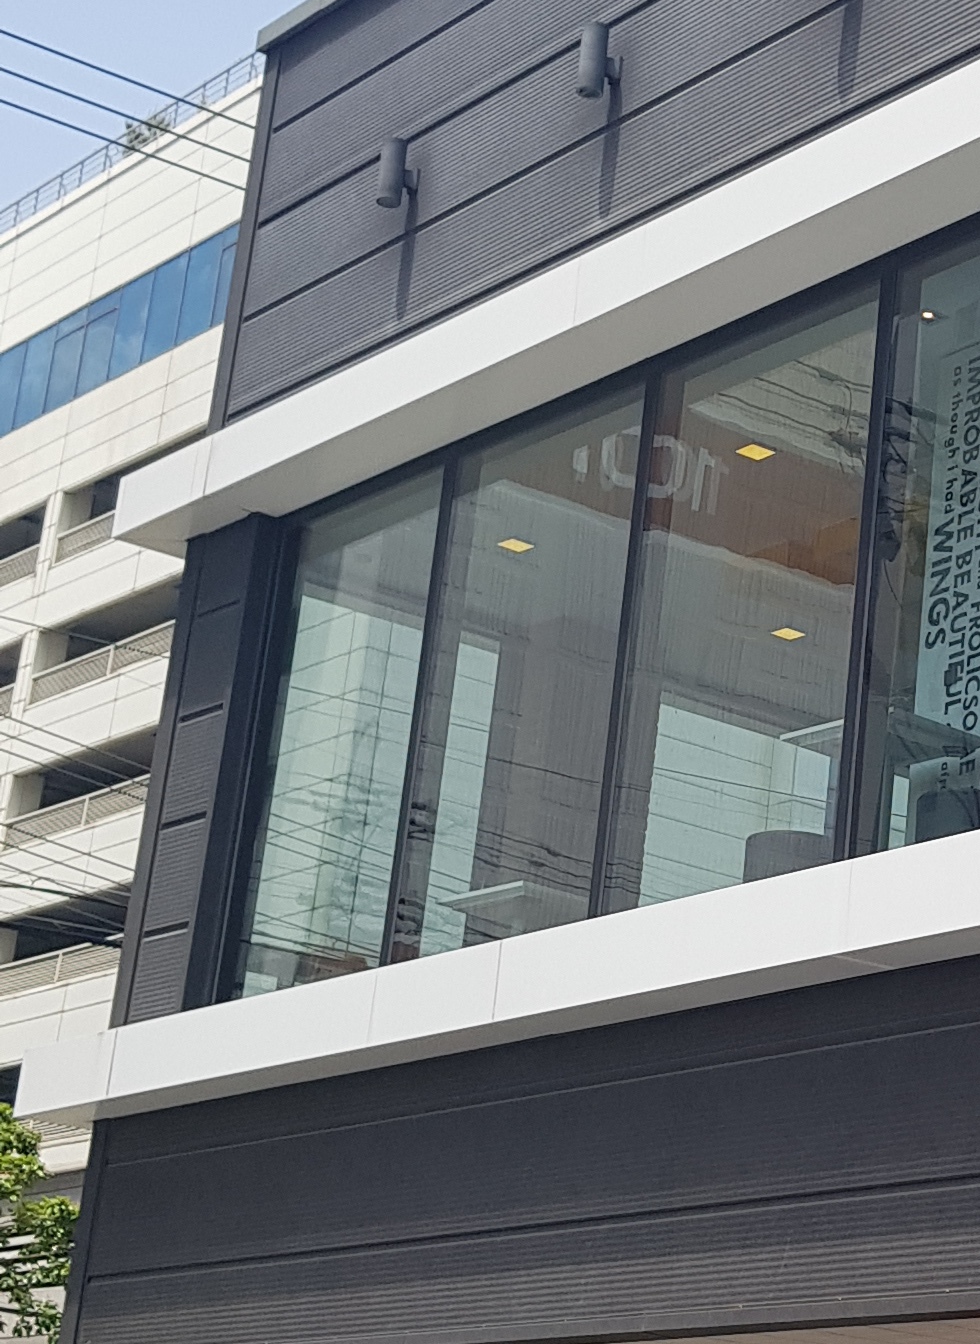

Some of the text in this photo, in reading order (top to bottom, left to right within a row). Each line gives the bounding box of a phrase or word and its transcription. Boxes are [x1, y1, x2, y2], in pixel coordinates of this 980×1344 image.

[952, 366, 961, 387] as
[944, 392, 964, 459] though
[944, 478, 959, 516] had
[925, 518, 955, 650] WINGS
